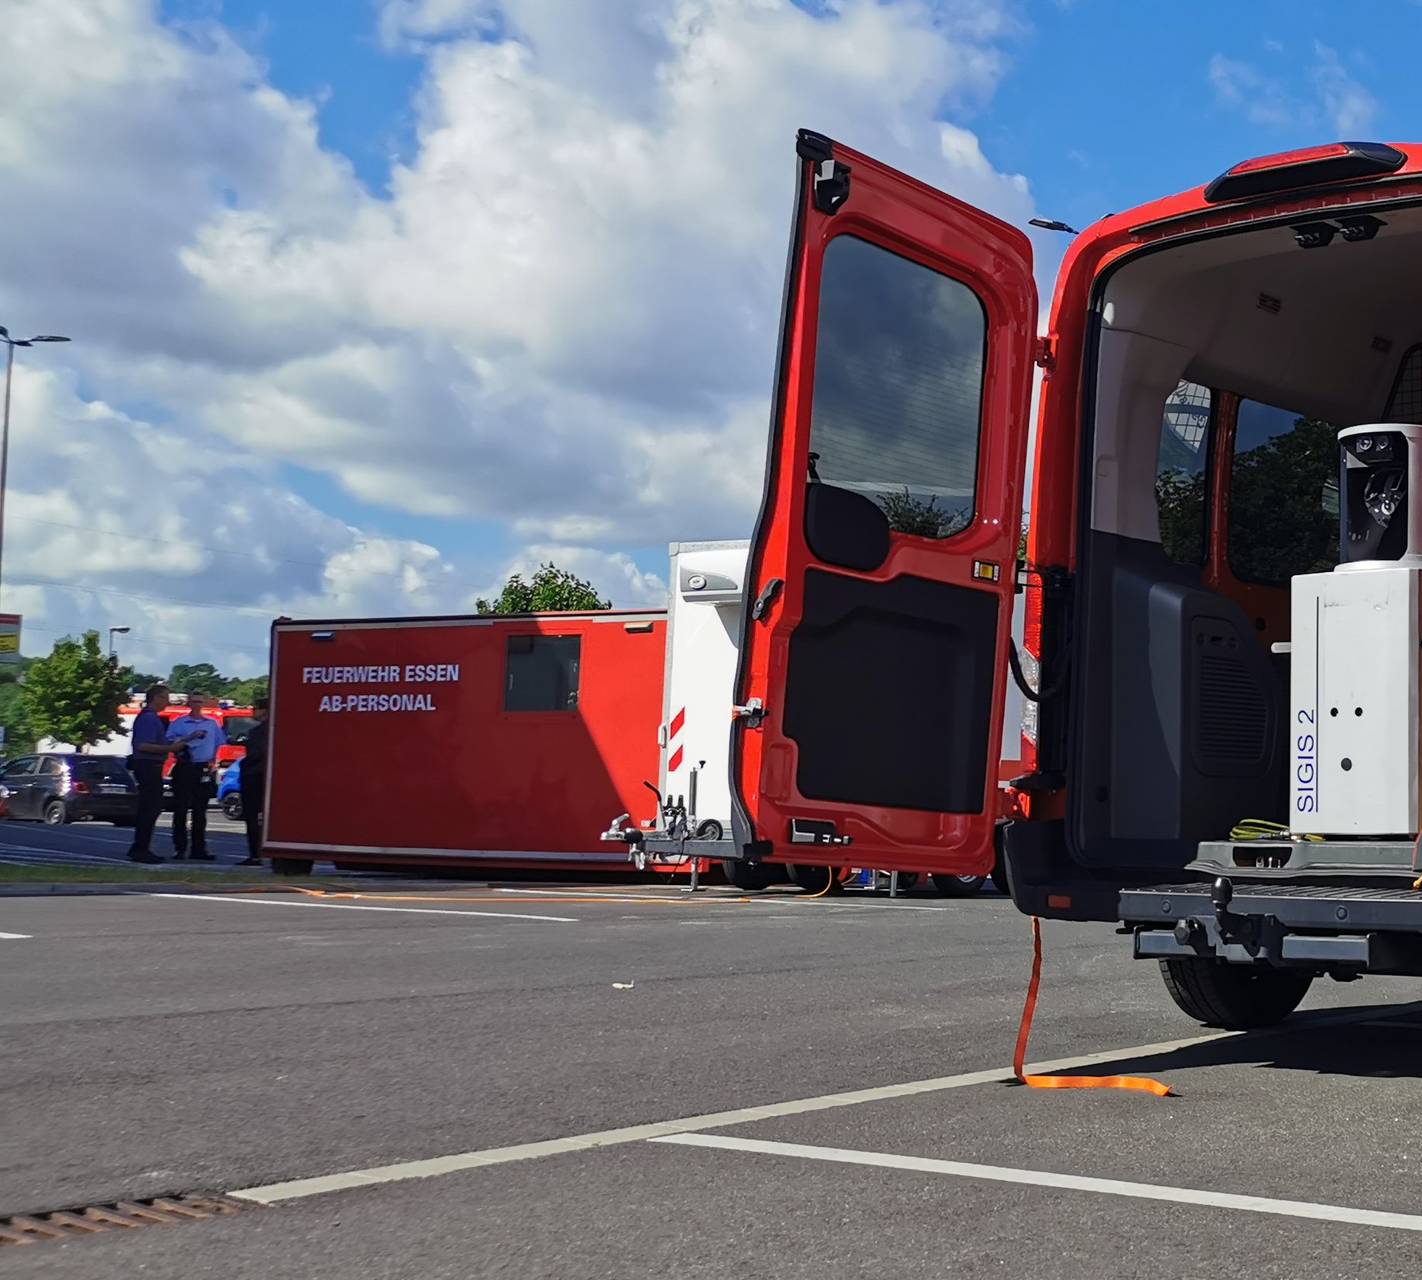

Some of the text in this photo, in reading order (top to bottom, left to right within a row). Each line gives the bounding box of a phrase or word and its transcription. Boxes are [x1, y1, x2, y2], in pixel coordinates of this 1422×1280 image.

[303, 664, 460, 683] FEUERWEHR ESSEN
[319, 694, 436, 712] AB-PERSONAL
[1296, 709, 1315, 813] SIGIS 2
